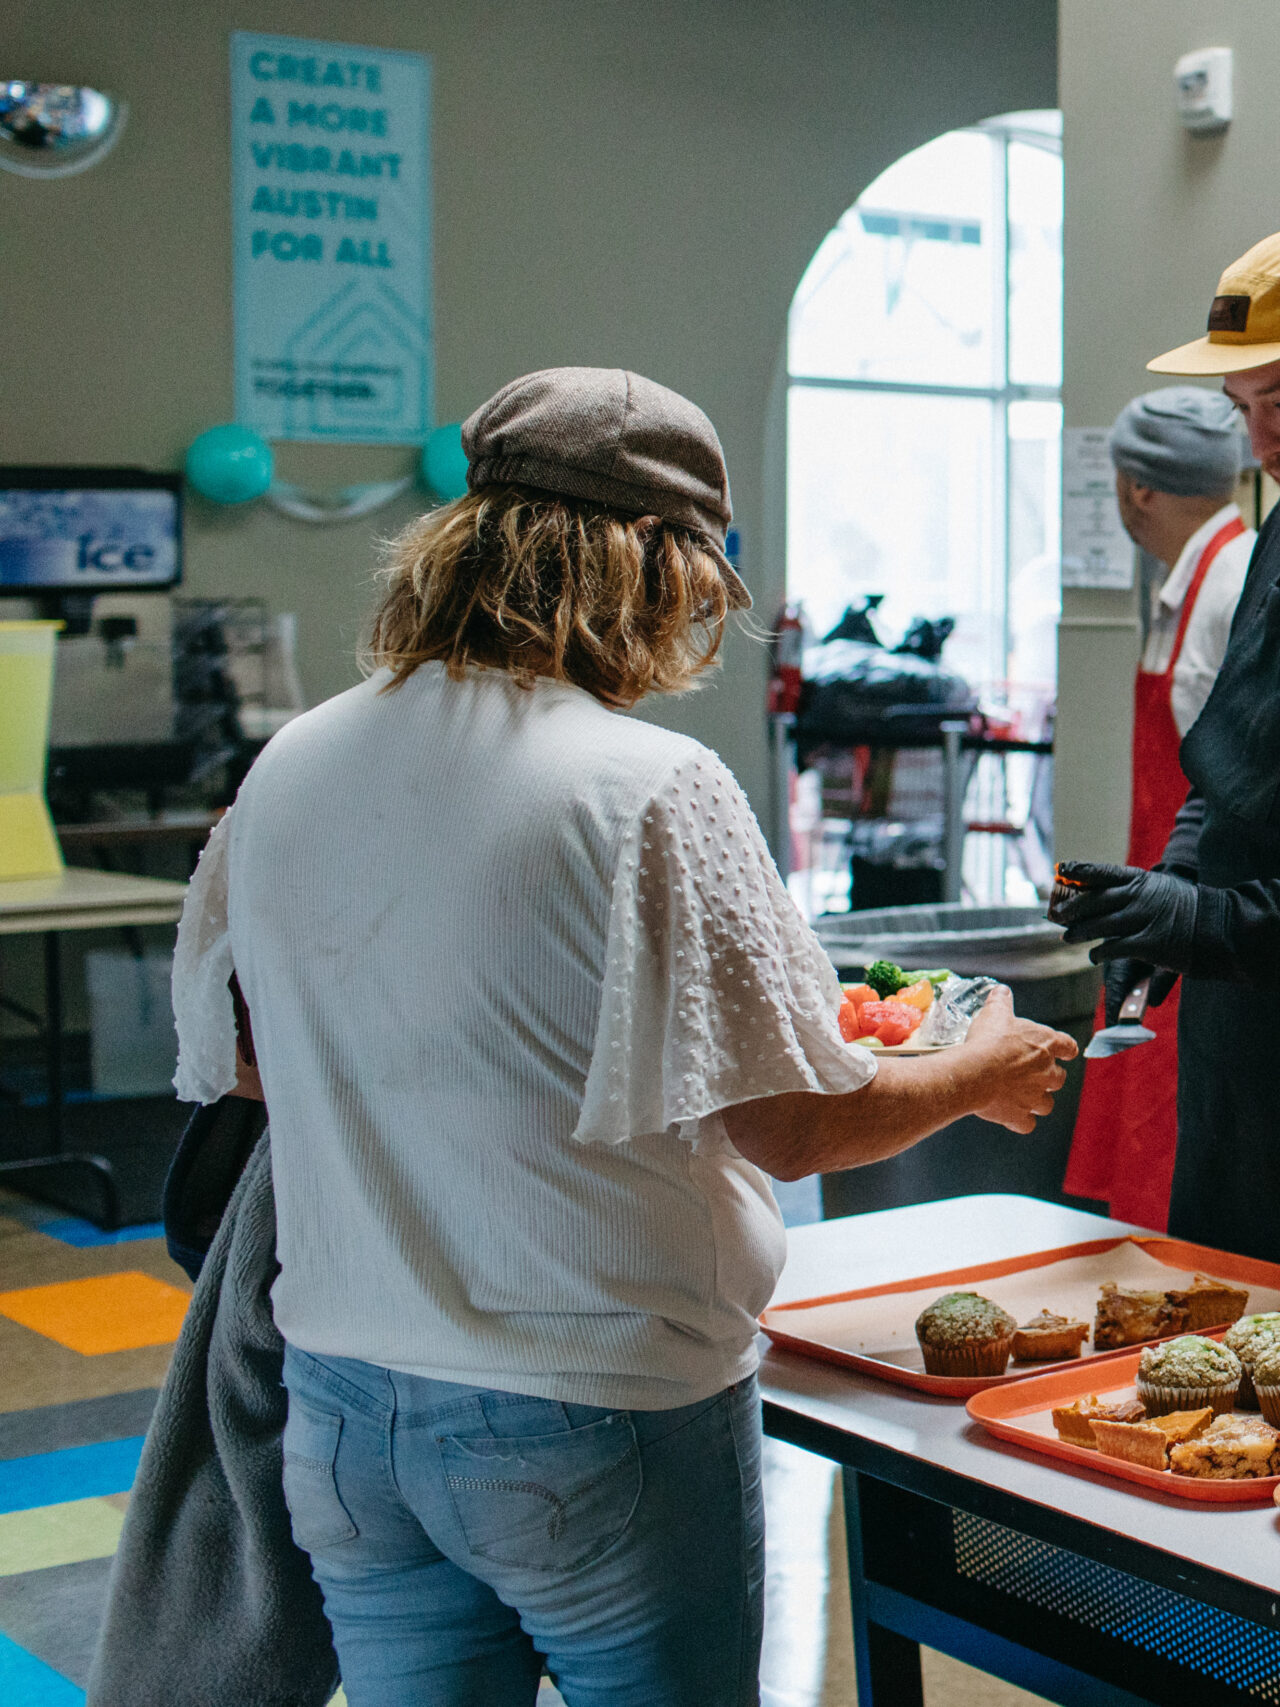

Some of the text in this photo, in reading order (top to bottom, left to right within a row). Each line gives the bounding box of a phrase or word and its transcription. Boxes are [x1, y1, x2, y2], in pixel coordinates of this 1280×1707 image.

[251, 52, 381, 93] CREATE
[251, 97, 387, 138] A MORE
[251, 143, 401, 179] VIBRANT
[251, 186, 377, 220] AUSTIN
[251, 230, 392, 268] FOR ALL
